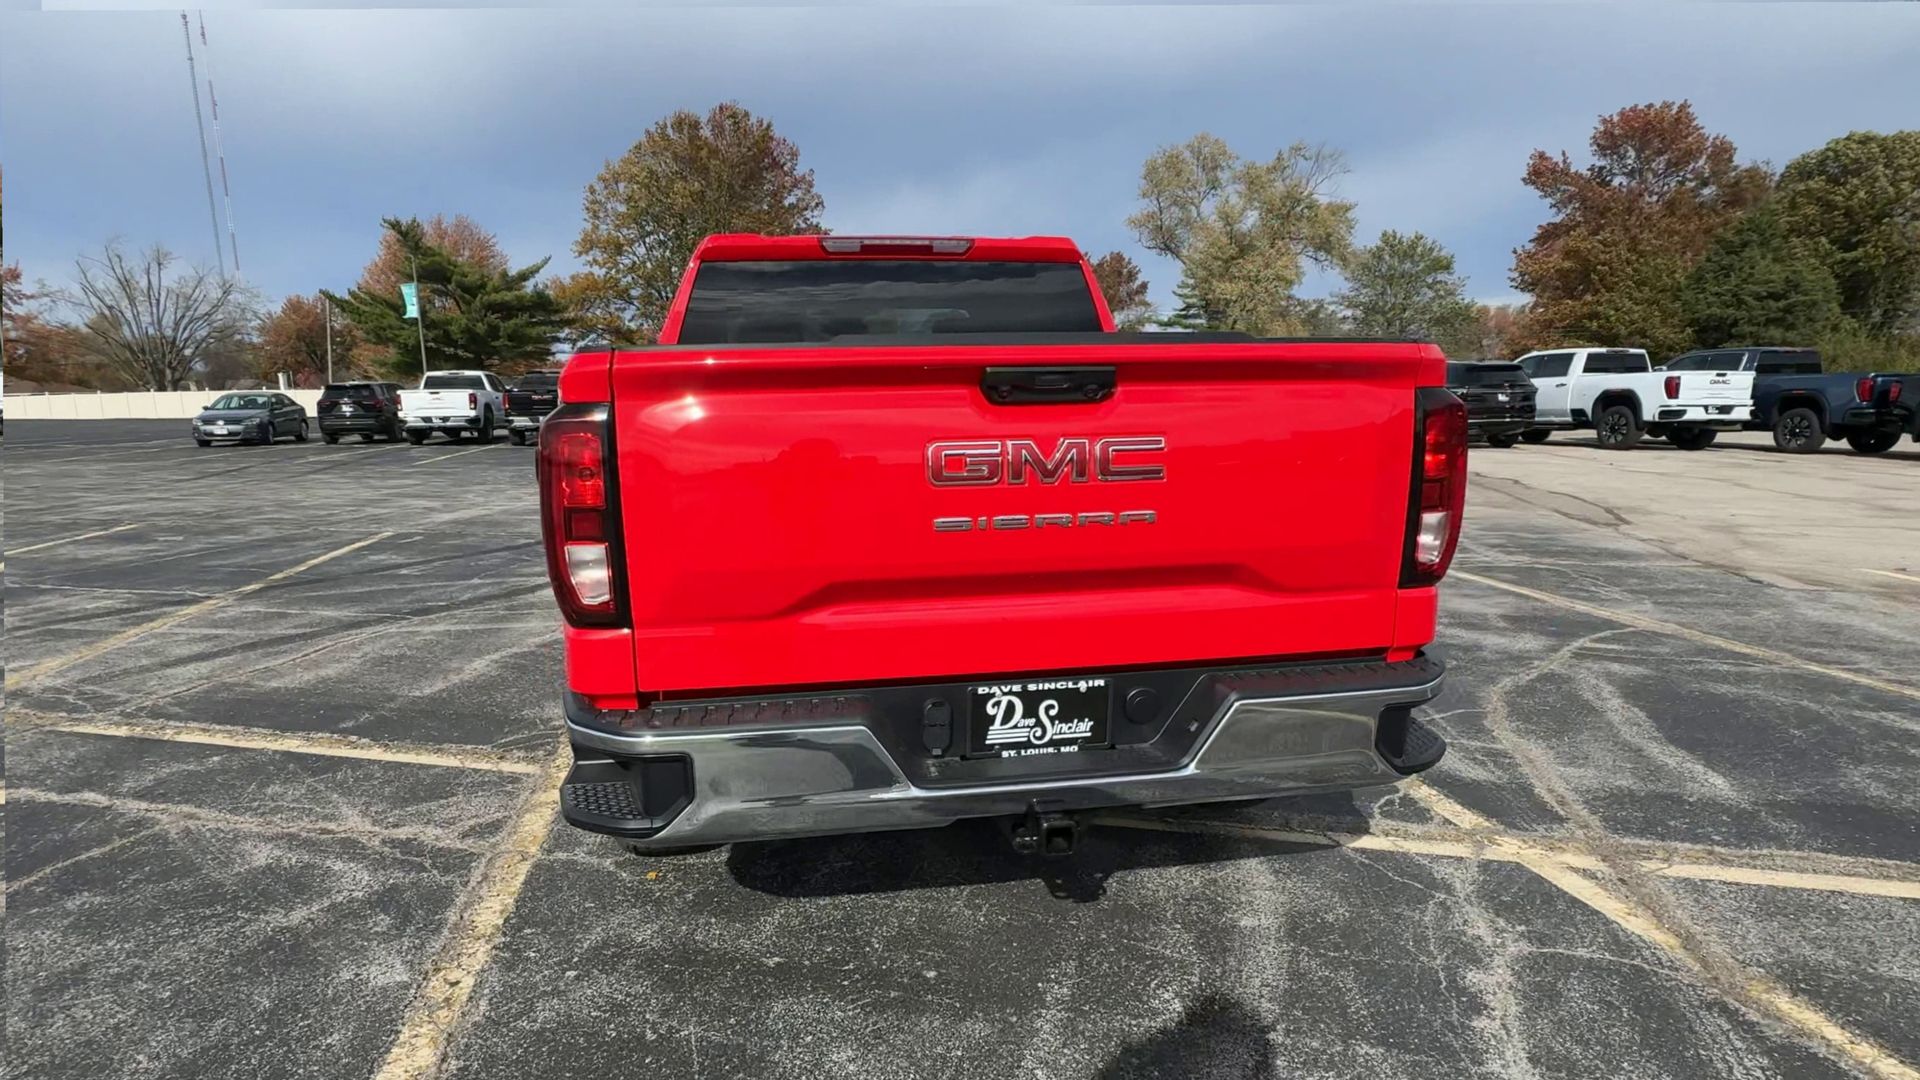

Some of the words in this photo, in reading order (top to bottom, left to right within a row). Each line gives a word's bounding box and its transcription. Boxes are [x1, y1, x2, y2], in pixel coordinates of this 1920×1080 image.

[927, 437, 1165, 486] GMC
[933, 510, 1157, 532] SIERRA
[978, 684, 1022, 694] DAVE
[1027, 679, 1105, 691] SINCLAIR
[986, 695, 1036, 731] Dave
[1029, 699, 1094, 745] Sinclair
[1001, 750, 1018, 758] ST.
[1060, 745, 1079, 753] MO
